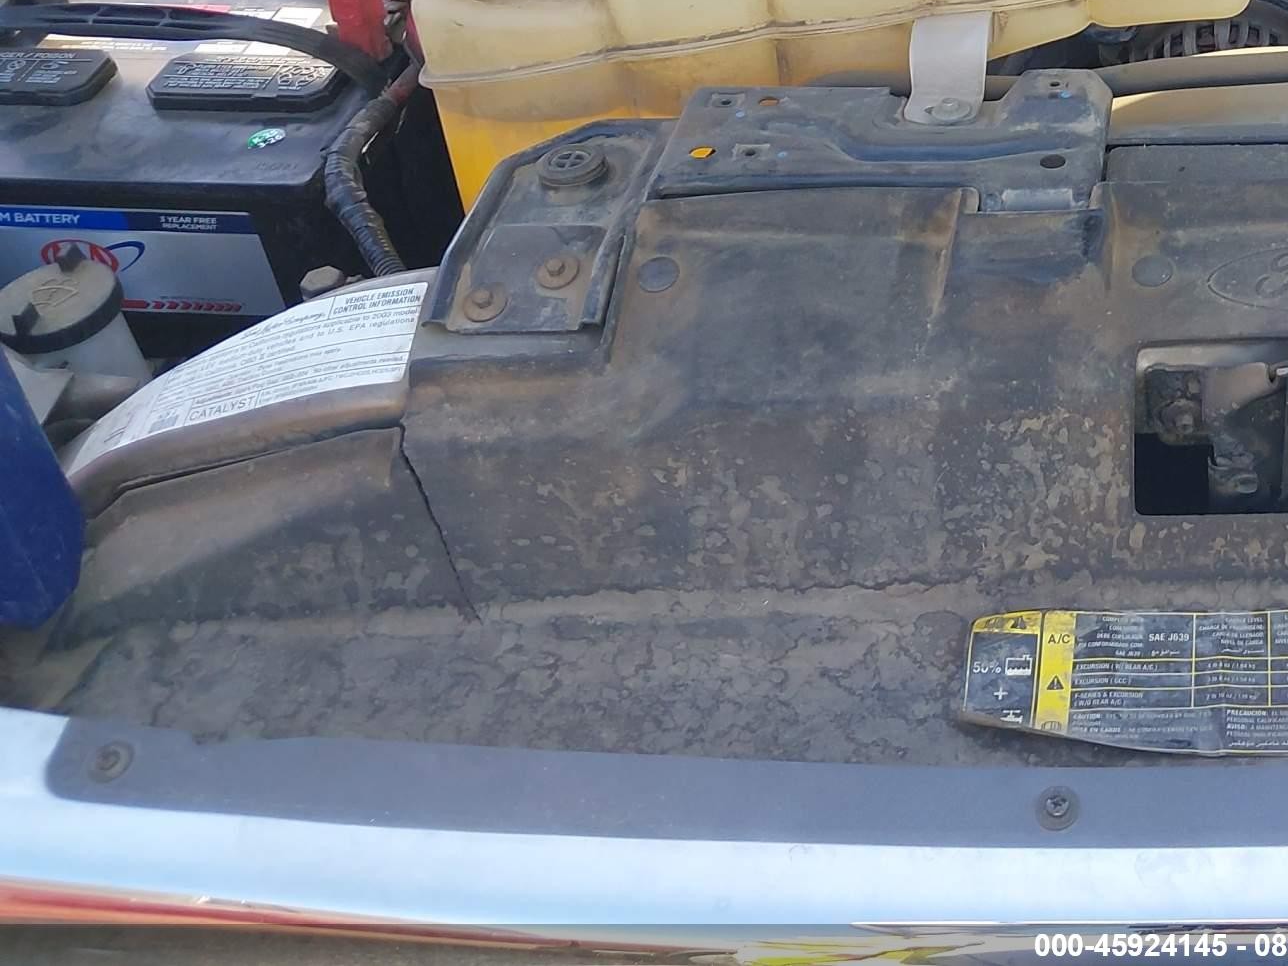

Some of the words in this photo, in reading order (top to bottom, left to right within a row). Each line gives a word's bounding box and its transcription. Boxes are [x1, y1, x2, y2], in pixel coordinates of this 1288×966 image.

[14, 212, 80, 224] BATTERY
[345, 295, 374, 305] VEHICLE
[377, 288, 414, 299] EMISSION
[333, 304, 367, 315] CONTROL
[368, 296, 420, 309] INFORMATION
[189, 395, 256, 421] CATALYST
[1047, 633, 1071, 644] A/C
[1149, 634, 1165, 642] SAE
[972, 661, 1002, 674] 50%
